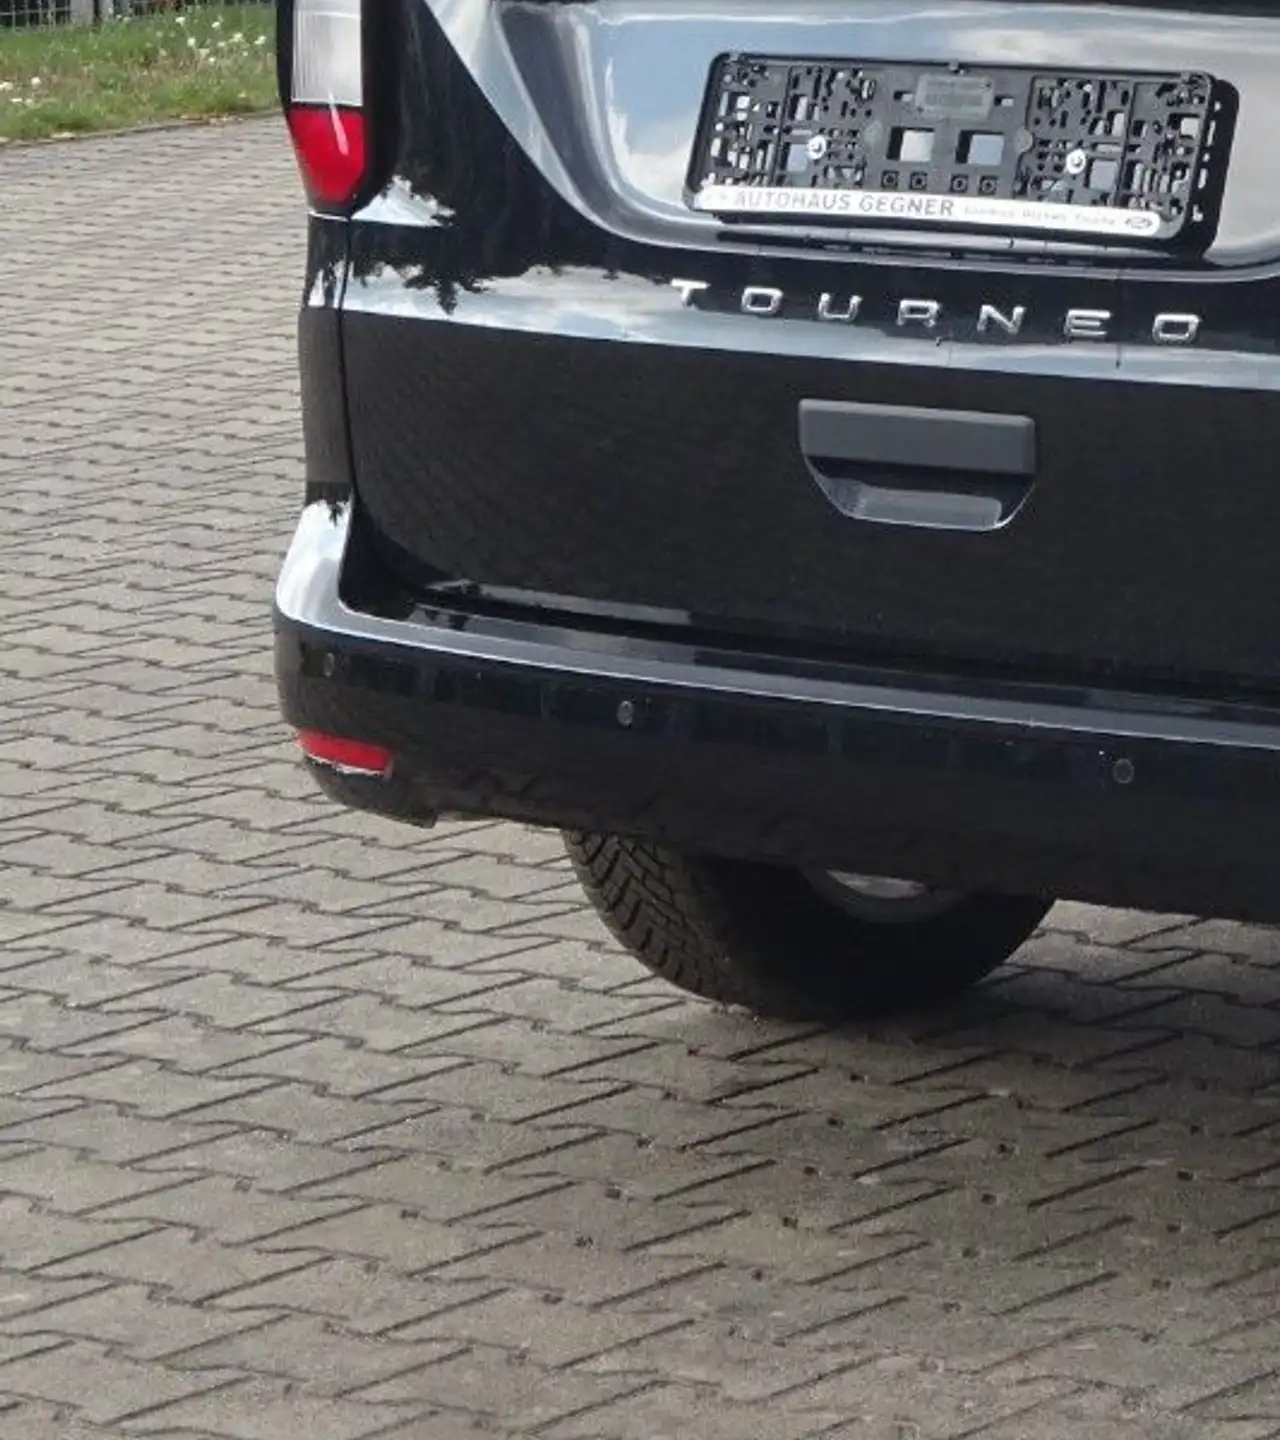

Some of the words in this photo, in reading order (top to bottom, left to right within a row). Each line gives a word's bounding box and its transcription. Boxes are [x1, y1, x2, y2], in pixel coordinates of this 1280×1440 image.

[734, 190, 850, 211] AUTOHAUS
[859, 194, 955, 217] GEGNER
[672, 279, 1200, 344] TOURNEO
